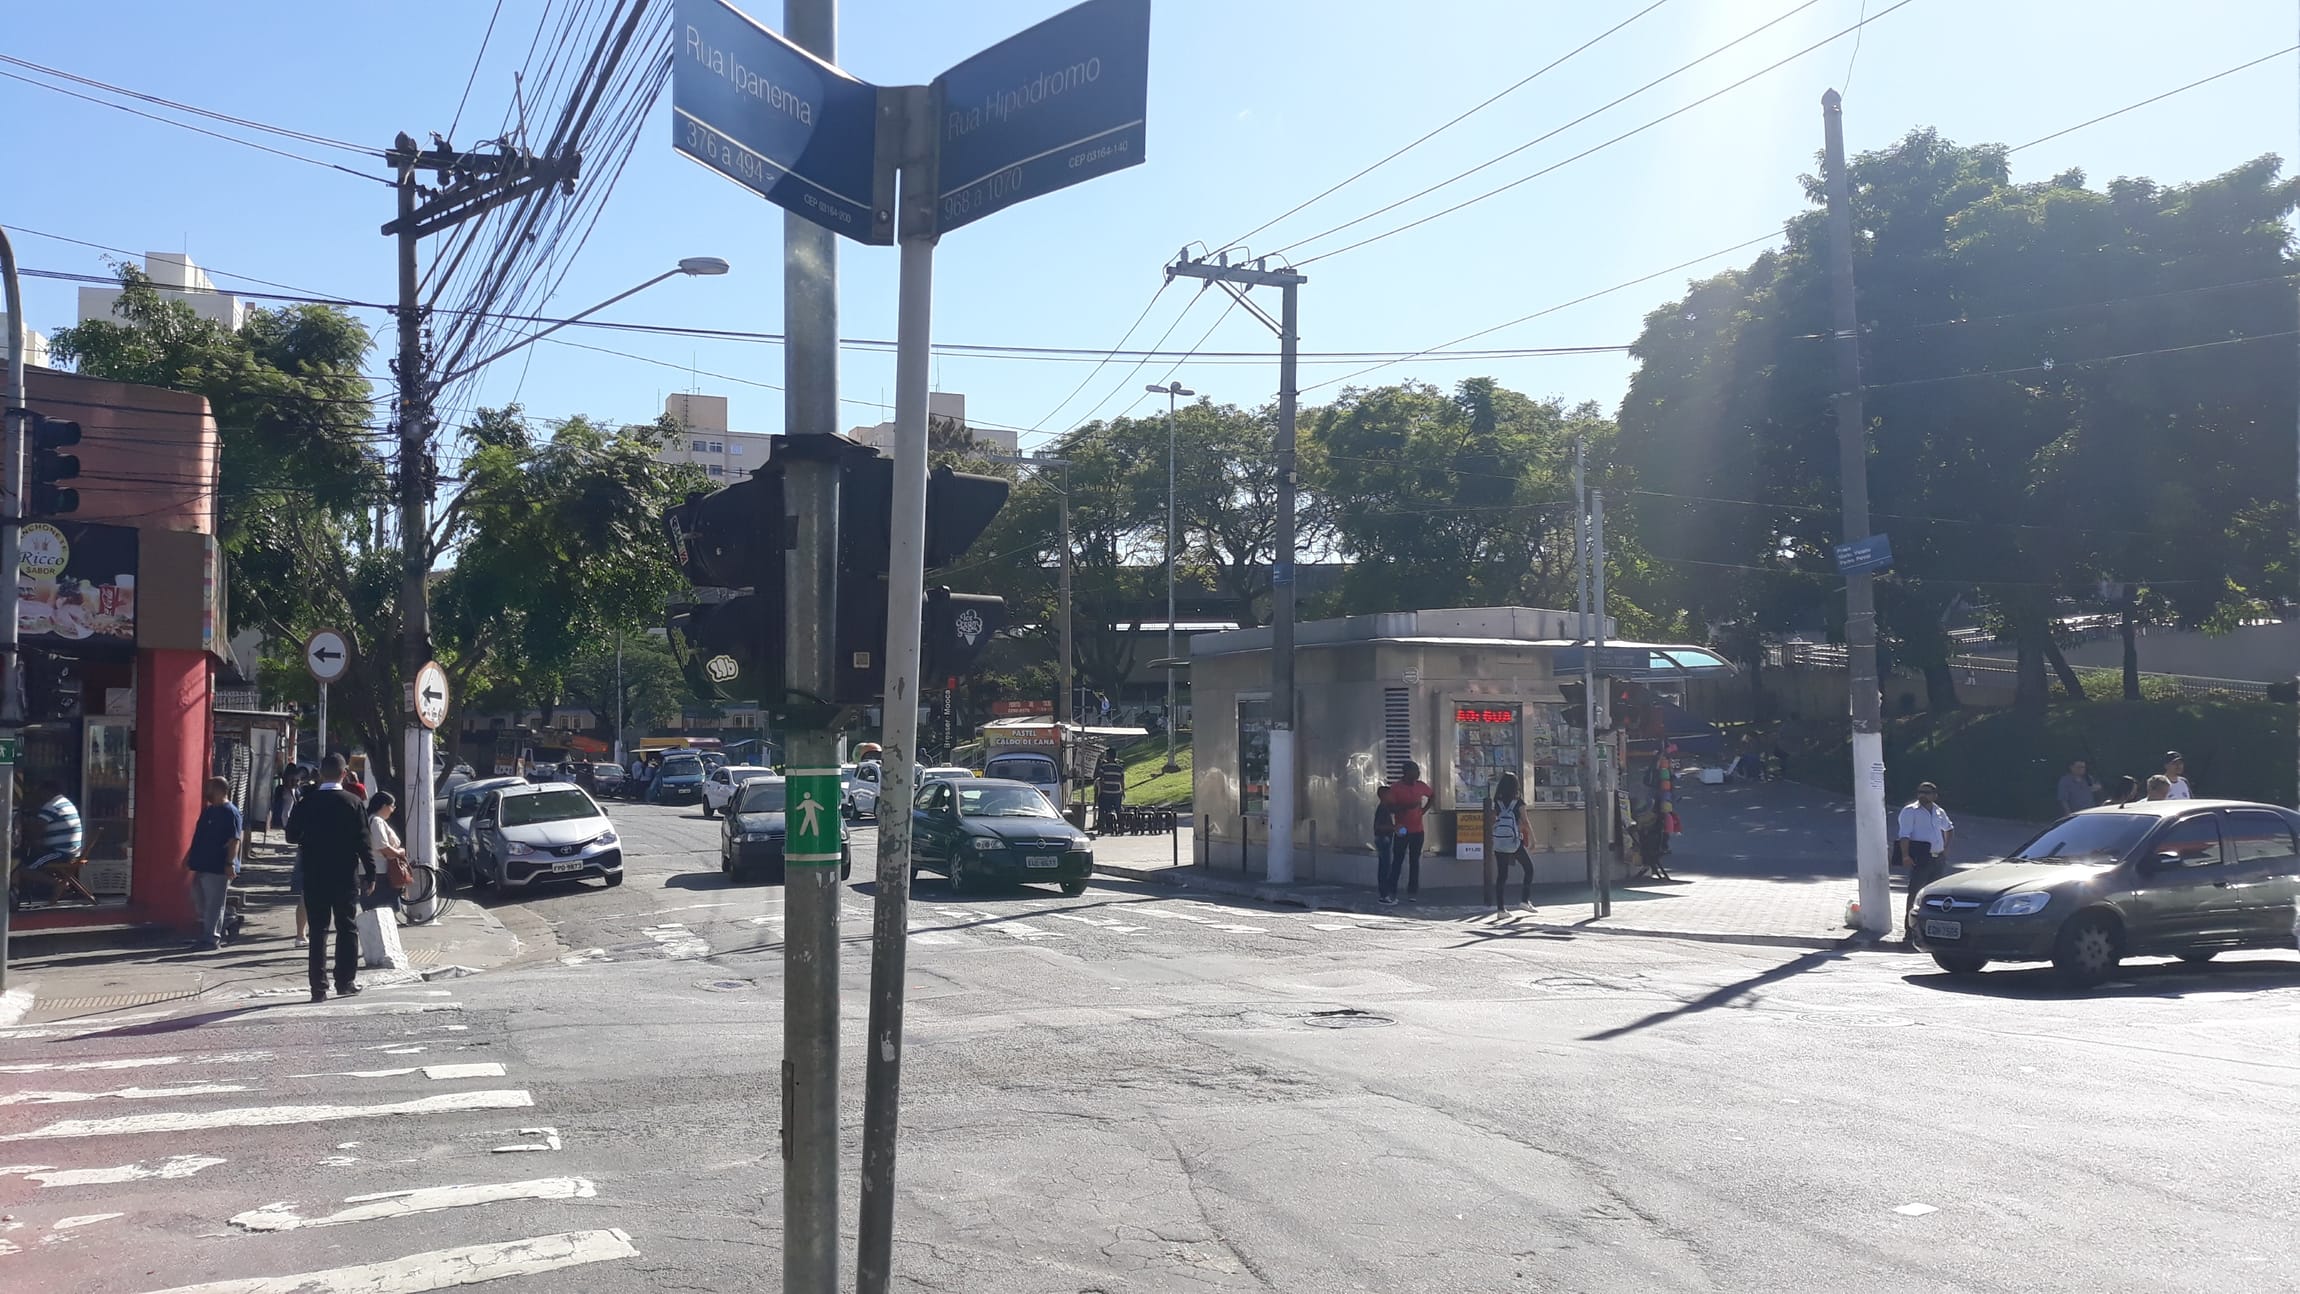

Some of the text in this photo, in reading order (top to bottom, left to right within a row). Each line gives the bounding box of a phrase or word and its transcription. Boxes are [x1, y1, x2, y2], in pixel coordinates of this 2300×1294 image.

[685, 23, 812, 127] Rua Ipanema
[947, 107, 980, 141] Rua
[687, 121, 763, 182] 376 a 494
[1068, 154, 1086, 169] CEP
[803, 193, 818, 207] CEP
[944, 166, 1023, 221] 968 a 1070
[20, 551, 65, 566] Ricco
[26, 566, 56, 575] SABOR
[1012, 729, 1037, 737] PASTEL
